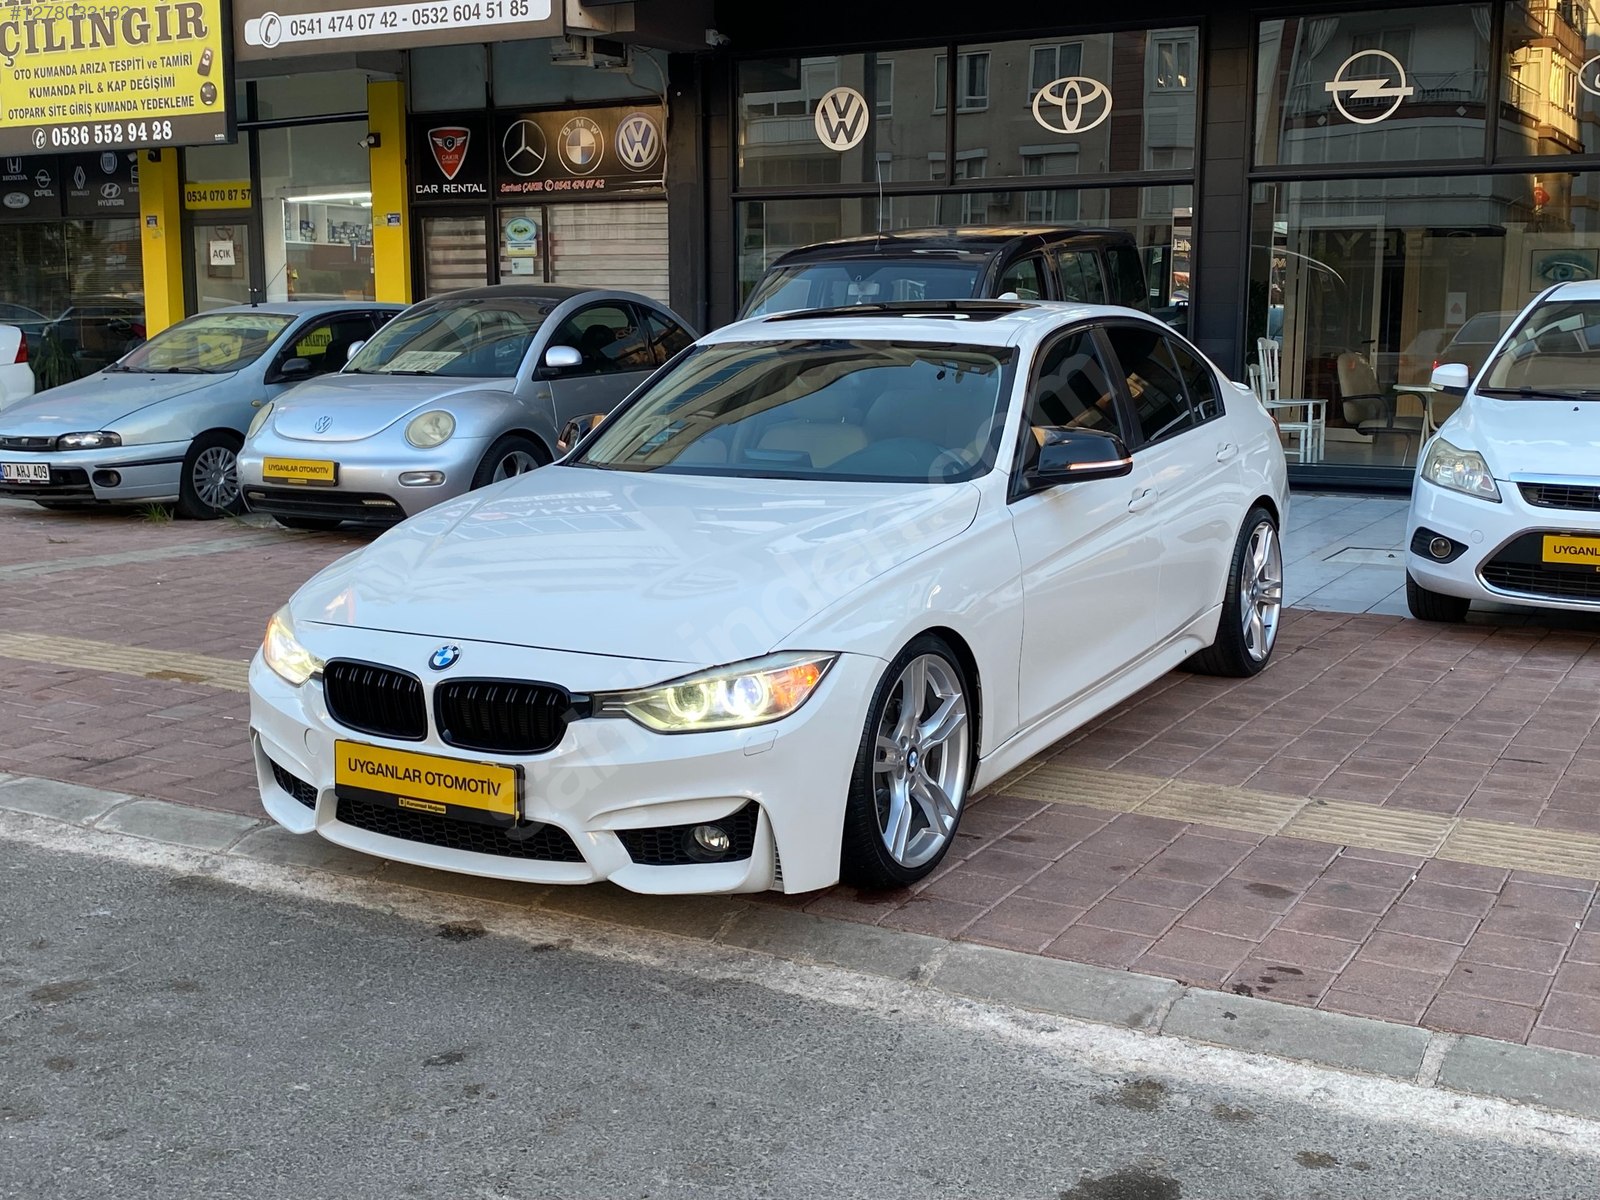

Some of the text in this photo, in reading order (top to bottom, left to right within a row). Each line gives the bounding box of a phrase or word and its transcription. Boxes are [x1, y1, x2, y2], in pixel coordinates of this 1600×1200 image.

[290, 20, 323, 36] 0541
[328, 16, 354, 33] 474
[358, 13, 375, 30] 07
[380, 11, 398, 28] 42
[412, 7, 449, 26] 0532
[453, 3, 481, 22] 604
[486, 1, 503, 19] 51
[510, 0, 529, 16] 85
[0, 0, 208, 67] ÇİLİNGİR
[14, 53, 193, 81] OTO KUMANDA ARIZA TESPİTİ ve TAMİRİ
[29, 75, 176, 99] KUMANDA PİL & KAP DEĞİŞİMİ
[8, 95, 194, 120] OTOPARK SİTE GİRİŞ KUMANDA YEDEKLEME
[51, 120, 173, 146] 0536 552 94 28
[563, 119, 600, 137] BMW
[34, 189, 54, 197] OPEL
[186, 188, 251, 202] 0534 070 87 57
[416, 182, 487, 194] CAR RENTAL
[212, 249, 231, 260] AÇIK
[3, 464, 47, 478] 07 AHJ 409
[268, 463, 298, 472] UYGANLAR
[348, 757, 501, 796] UYGANLAR OTOMOTİV
